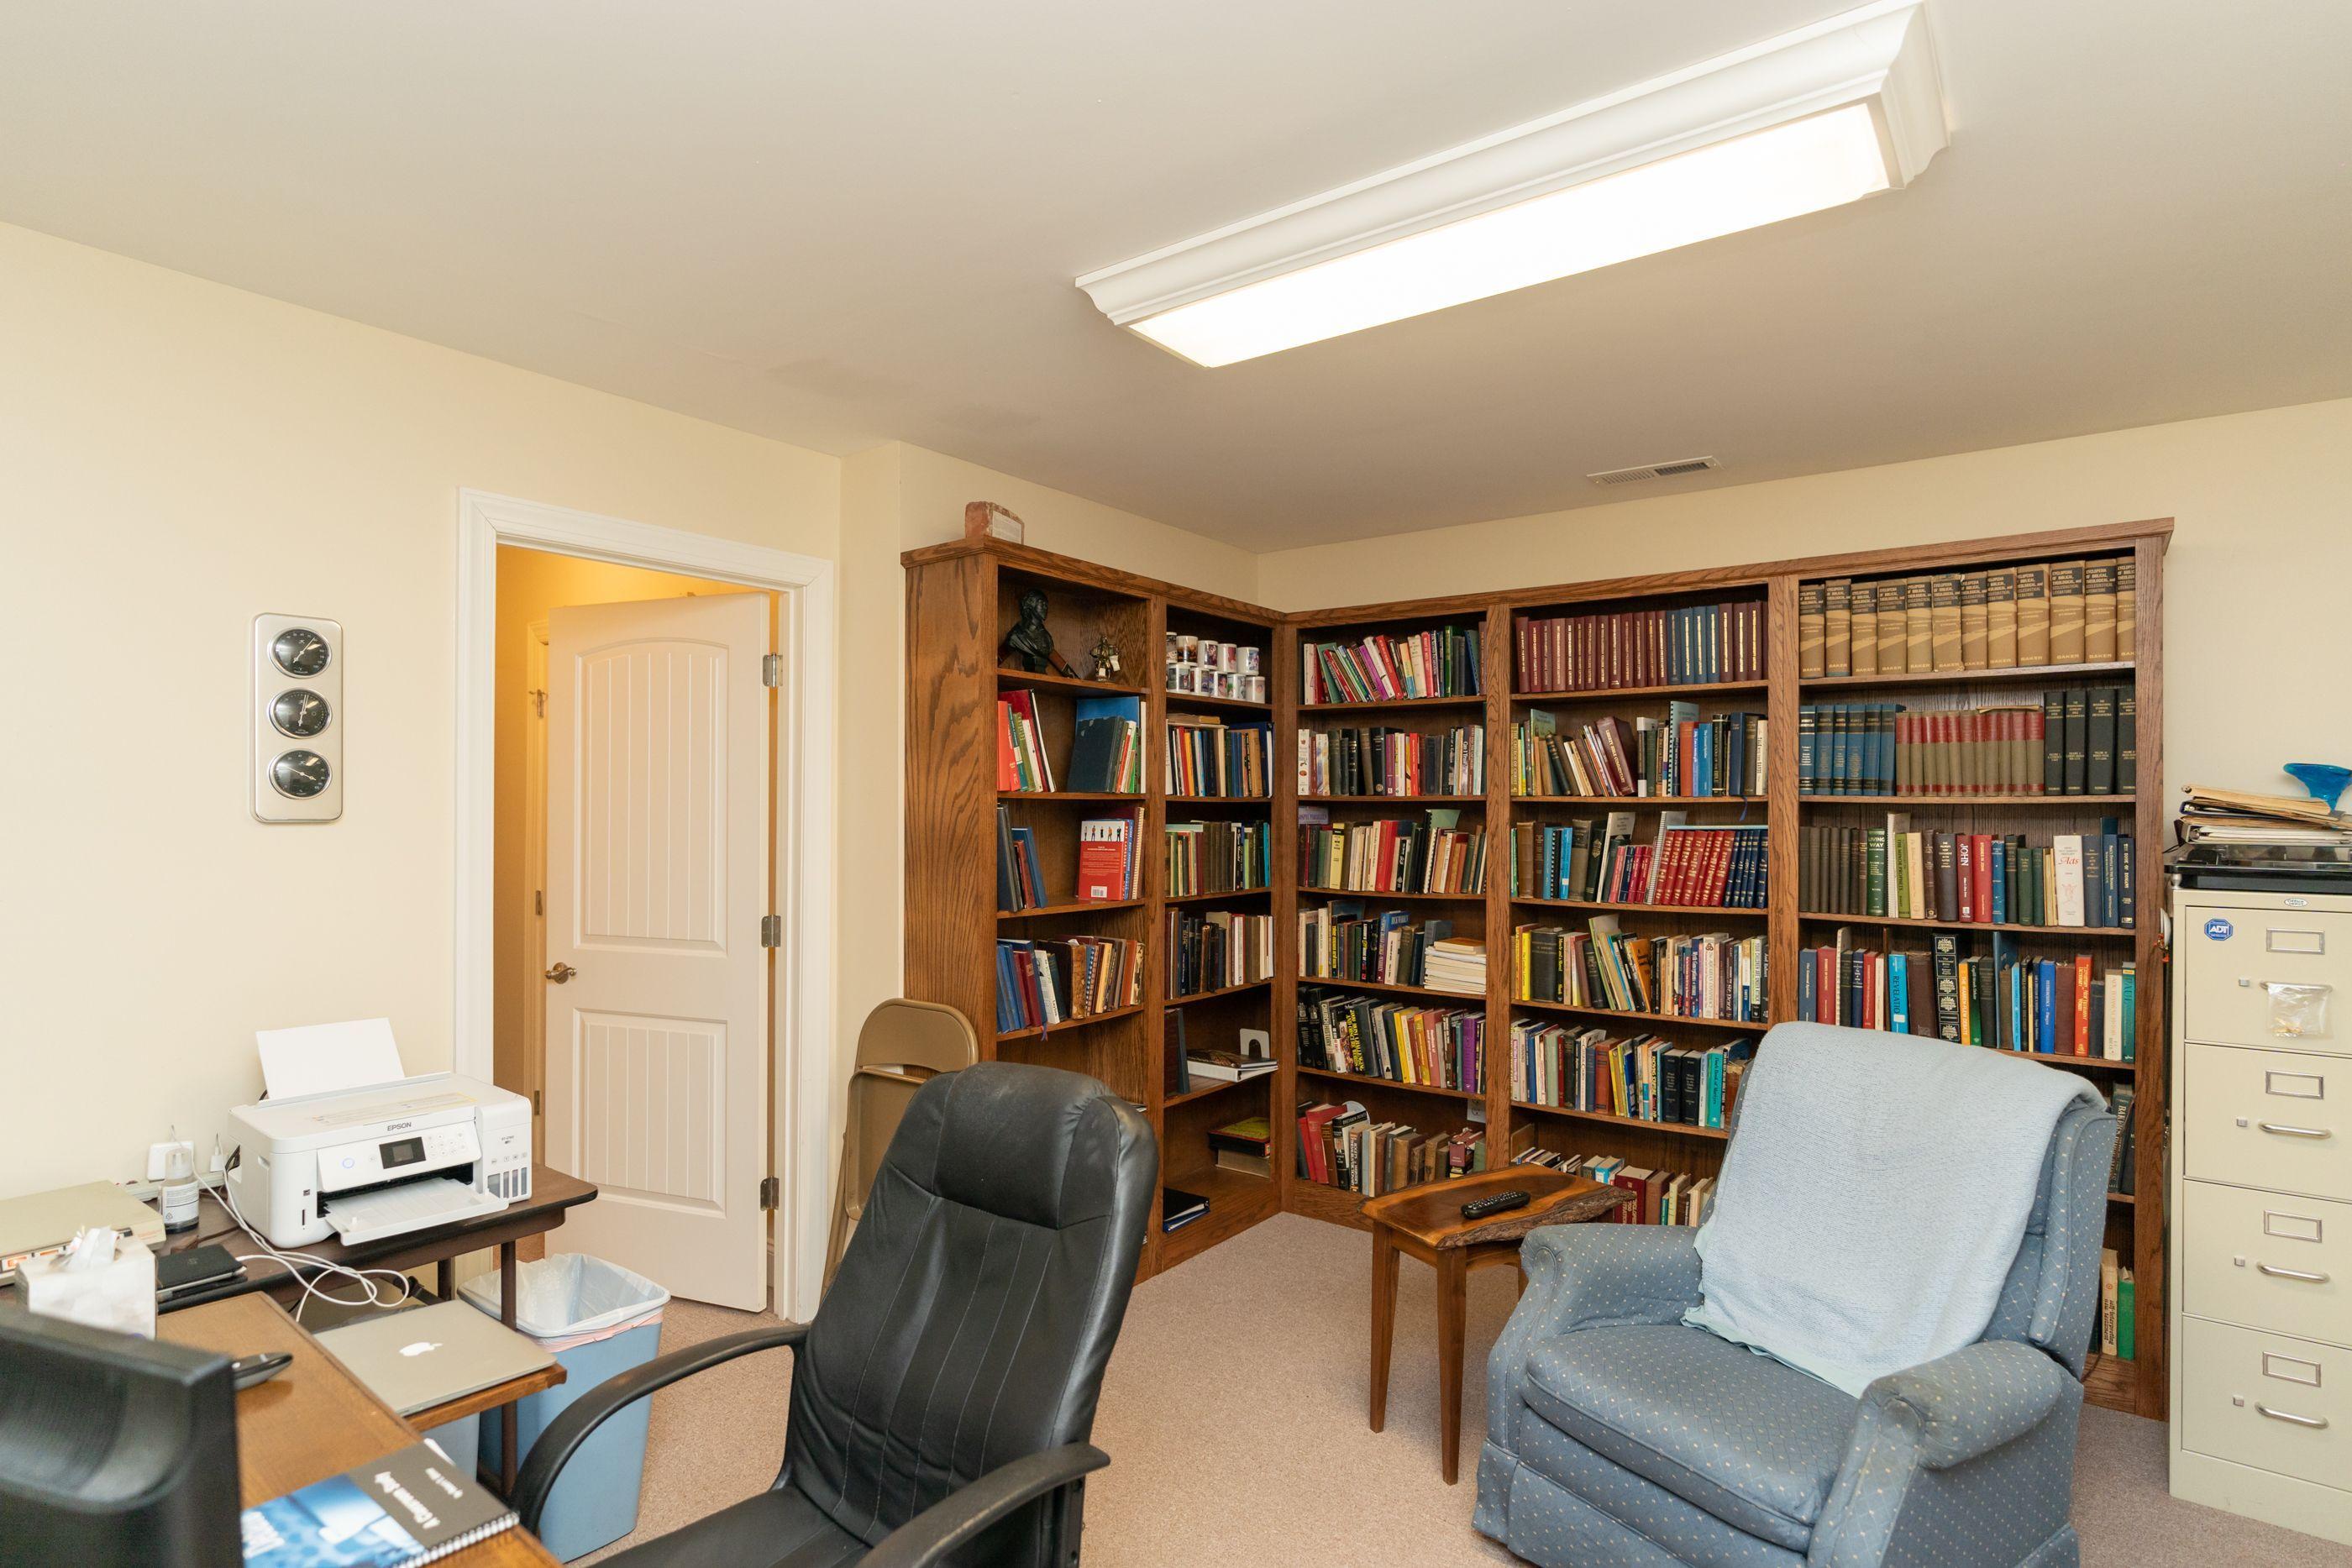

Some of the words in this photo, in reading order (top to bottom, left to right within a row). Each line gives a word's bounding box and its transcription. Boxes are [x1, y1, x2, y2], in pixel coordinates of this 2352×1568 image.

[1604, 729, 1613, 746] LIBERTY
[1614, 758, 1625, 783] COMMENTARY
[1959, 843, 1969, 867] JOHN
[2058, 857, 2080, 865] Acts
[2209, 926, 2229, 934] ADT
[1324, 1025, 1333, 1047] HISTORY
[1354, 1036, 1365, 1072] CHALLENGING
[386, 1122, 412, 1131] EPSON
